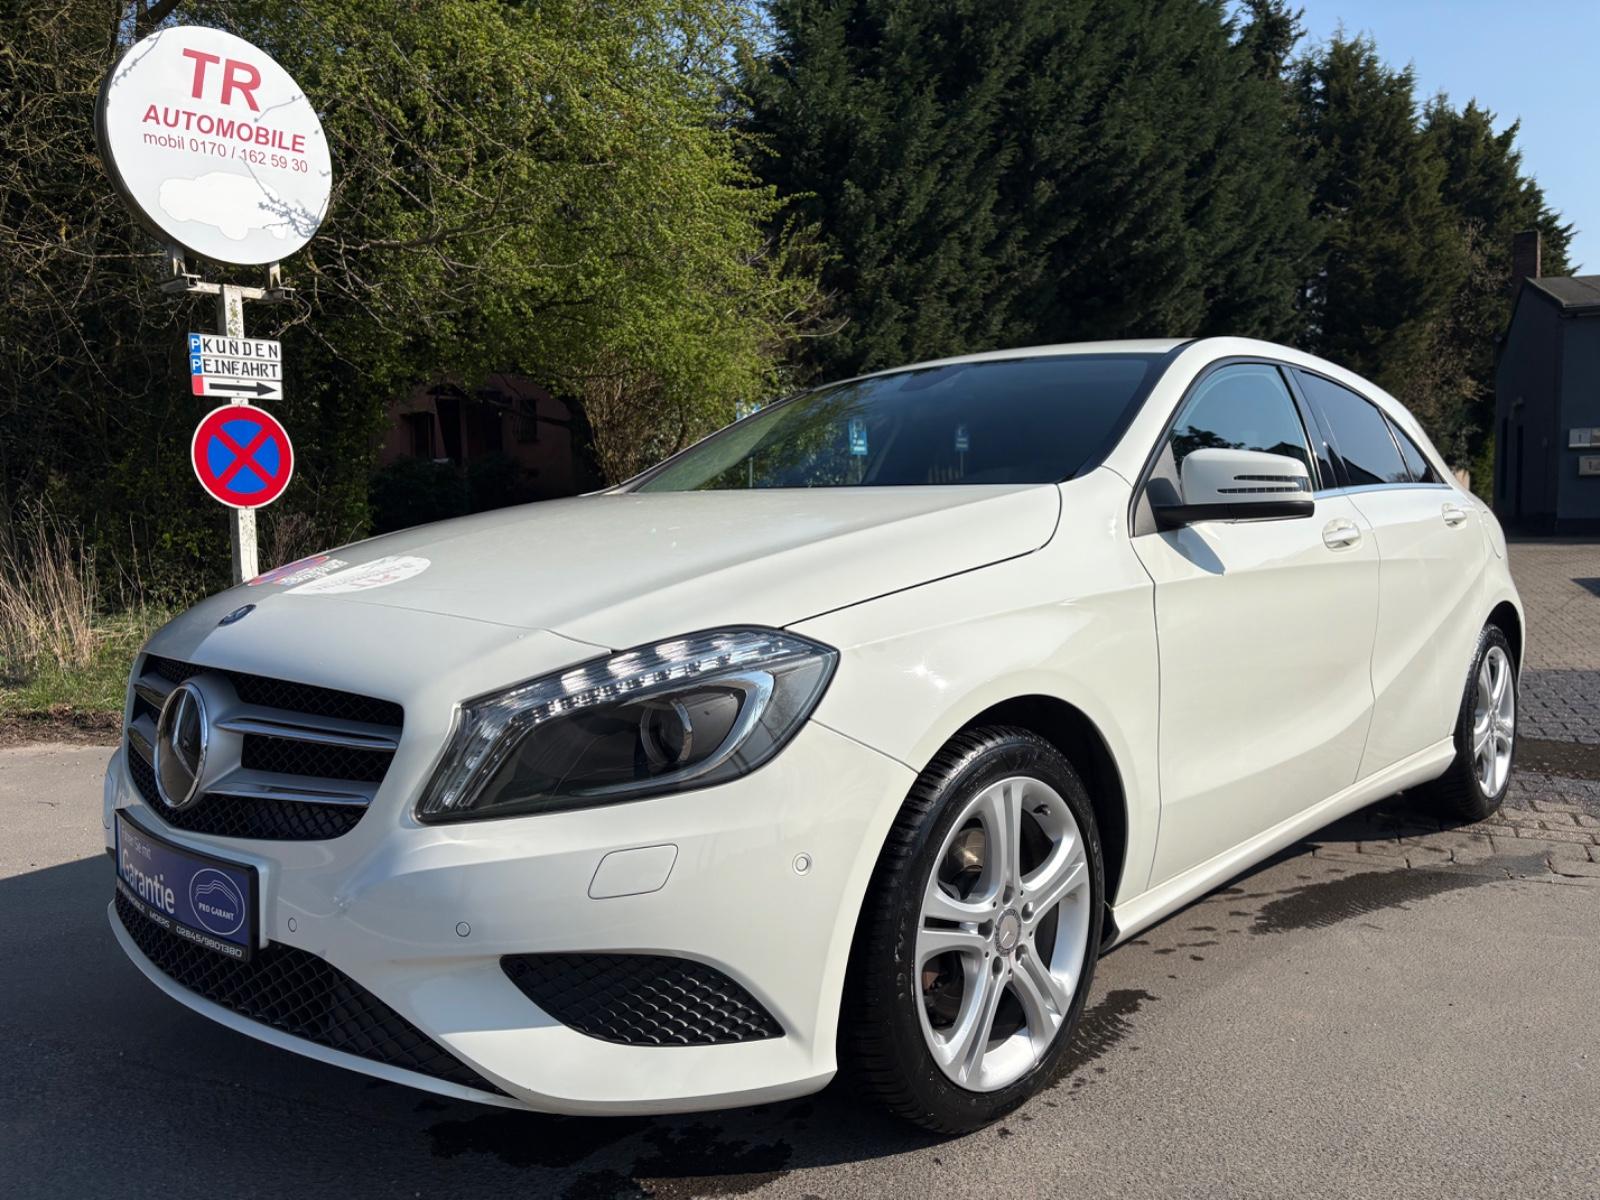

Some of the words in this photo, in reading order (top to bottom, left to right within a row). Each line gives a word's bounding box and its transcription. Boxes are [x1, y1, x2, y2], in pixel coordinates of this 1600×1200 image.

[182, 47, 262, 113] TR
[142, 104, 306, 154] AUTOMOBILE
[143, 132, 185, 148] mobil
[189, 138, 227, 158] 0170
[241, 149, 266, 165] 162
[271, 155, 288, 169] 59
[291, 158, 308, 173] 30
[202, 338, 278, 359] KUNDEN
[202, 359, 278, 378] EINFAHRT
[122, 849, 175, 914] Garantie
[198, 902, 210, 913] PRO
[211, 906, 234, 921] GARANT
